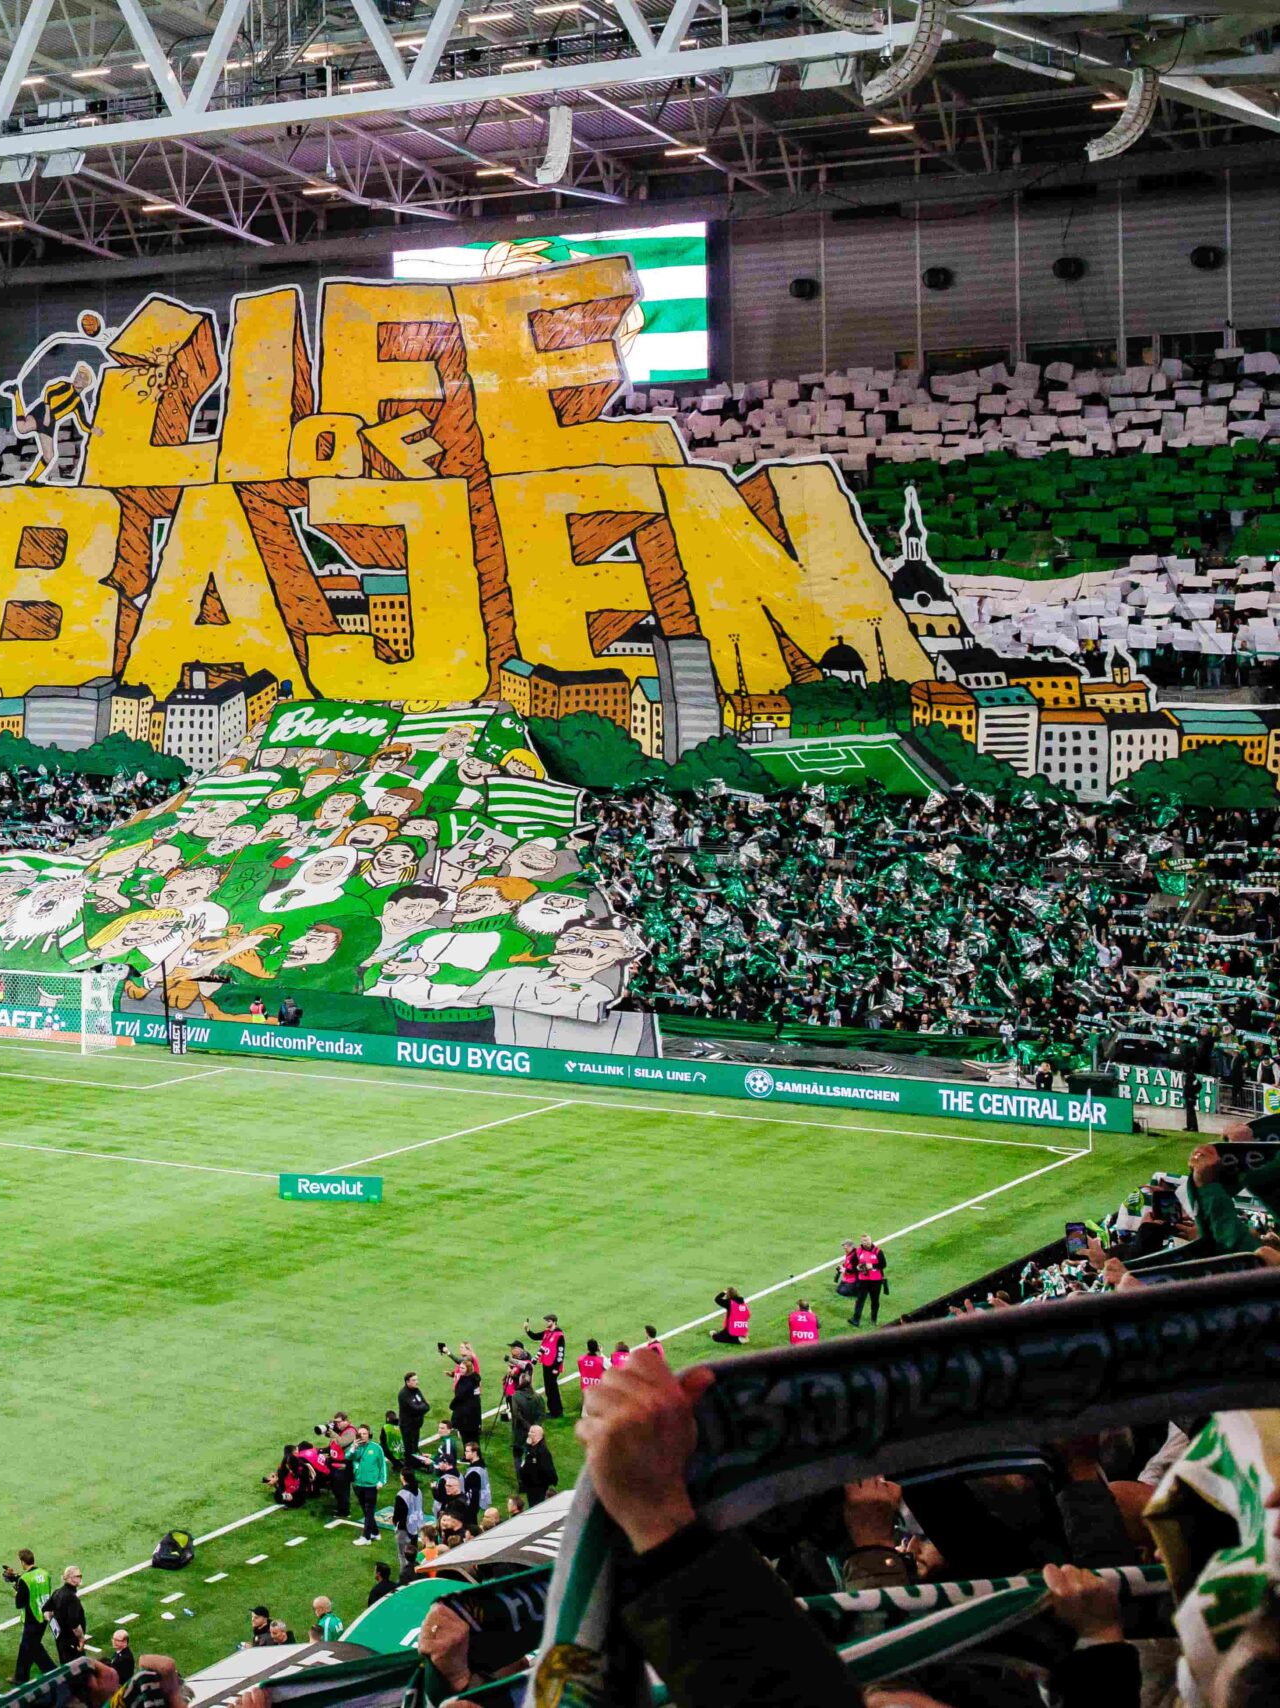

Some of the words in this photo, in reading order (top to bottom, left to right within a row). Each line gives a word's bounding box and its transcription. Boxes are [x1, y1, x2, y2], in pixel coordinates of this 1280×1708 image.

[81, 255, 690, 488] LIFE
[287, 410, 452, 482] OF
[269, 706, 389, 746] Bajen
[450, 813, 546, 845] HF
[115, 1019, 141, 1036] TVÅ
[240, 1029, 363, 1056] AudicomPendax
[397, 1041, 460, 1068] RUGU
[466, 1047, 530, 1073] BYGG
[578, 1062, 624, 1076] TALLINK
[634, 1068, 664, 1081] SILJA
[666, 1071, 691, 1082] LINE
[1119, 1065, 1214, 1094] FRAMT
[776, 1081, 900, 1102] SAMHÄLLSMATCHEN
[939, 1089, 975, 1113] THE
[979, 1092, 1064, 1121] CENTRAL
[1068, 1100, 1107, 1125] BAR
[298, 1178, 363, 1195] Revolut
[792, 1331, 814, 1339] FOTO
